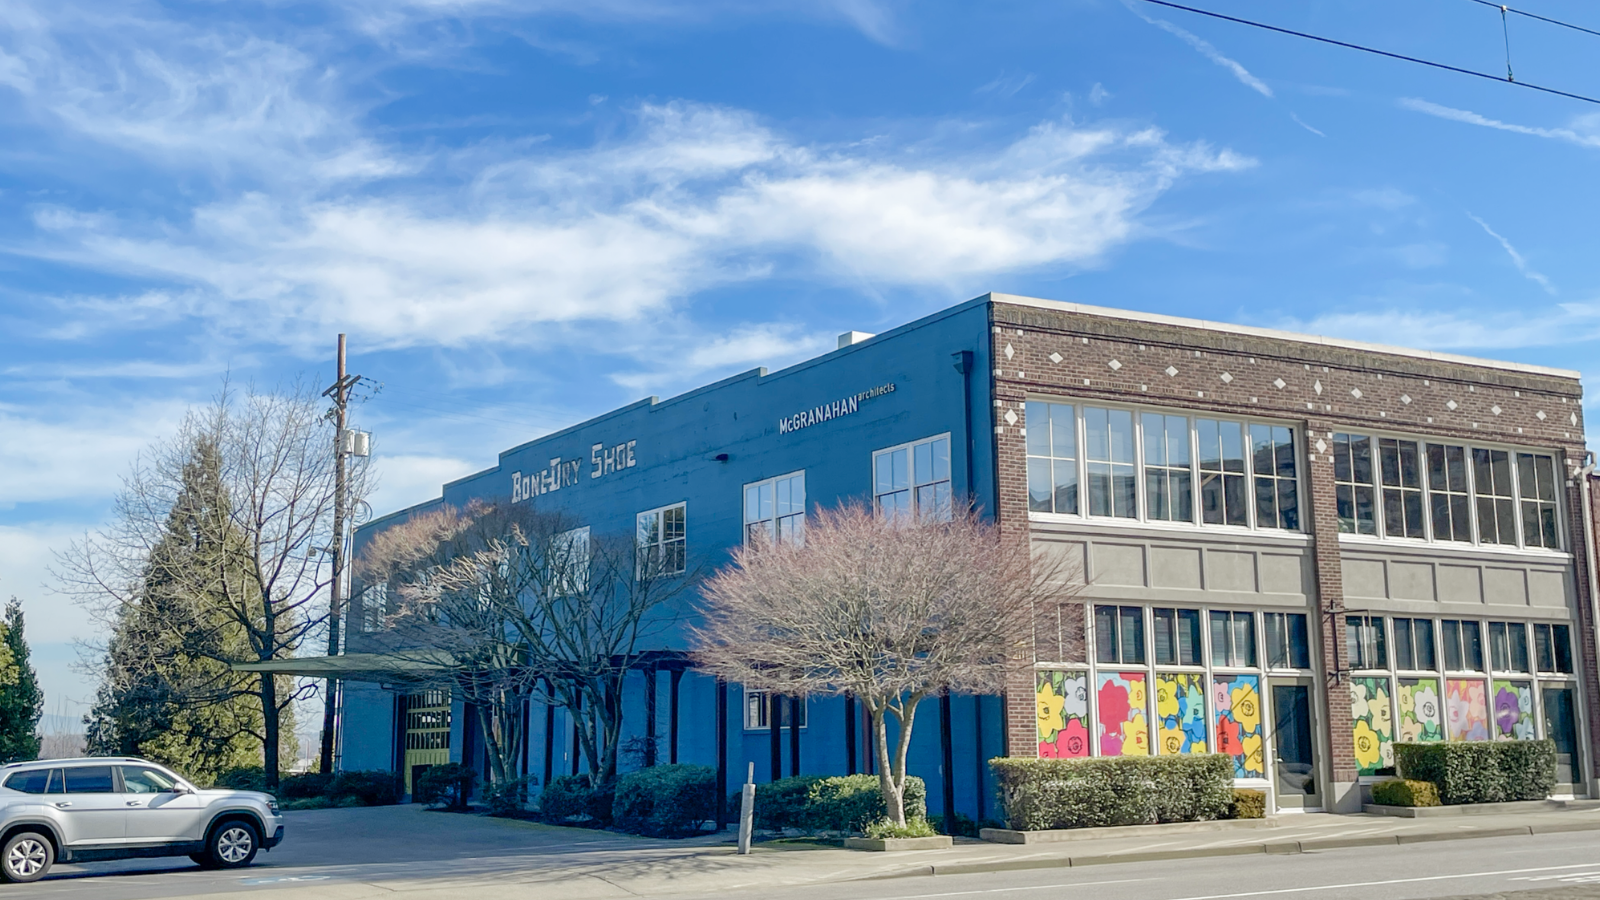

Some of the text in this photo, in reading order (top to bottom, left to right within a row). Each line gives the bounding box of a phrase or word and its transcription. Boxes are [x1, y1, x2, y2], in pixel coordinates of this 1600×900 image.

[779, 383, 895, 435] McGRANAHAN architects
[591, 440, 637, 479] SHOE
